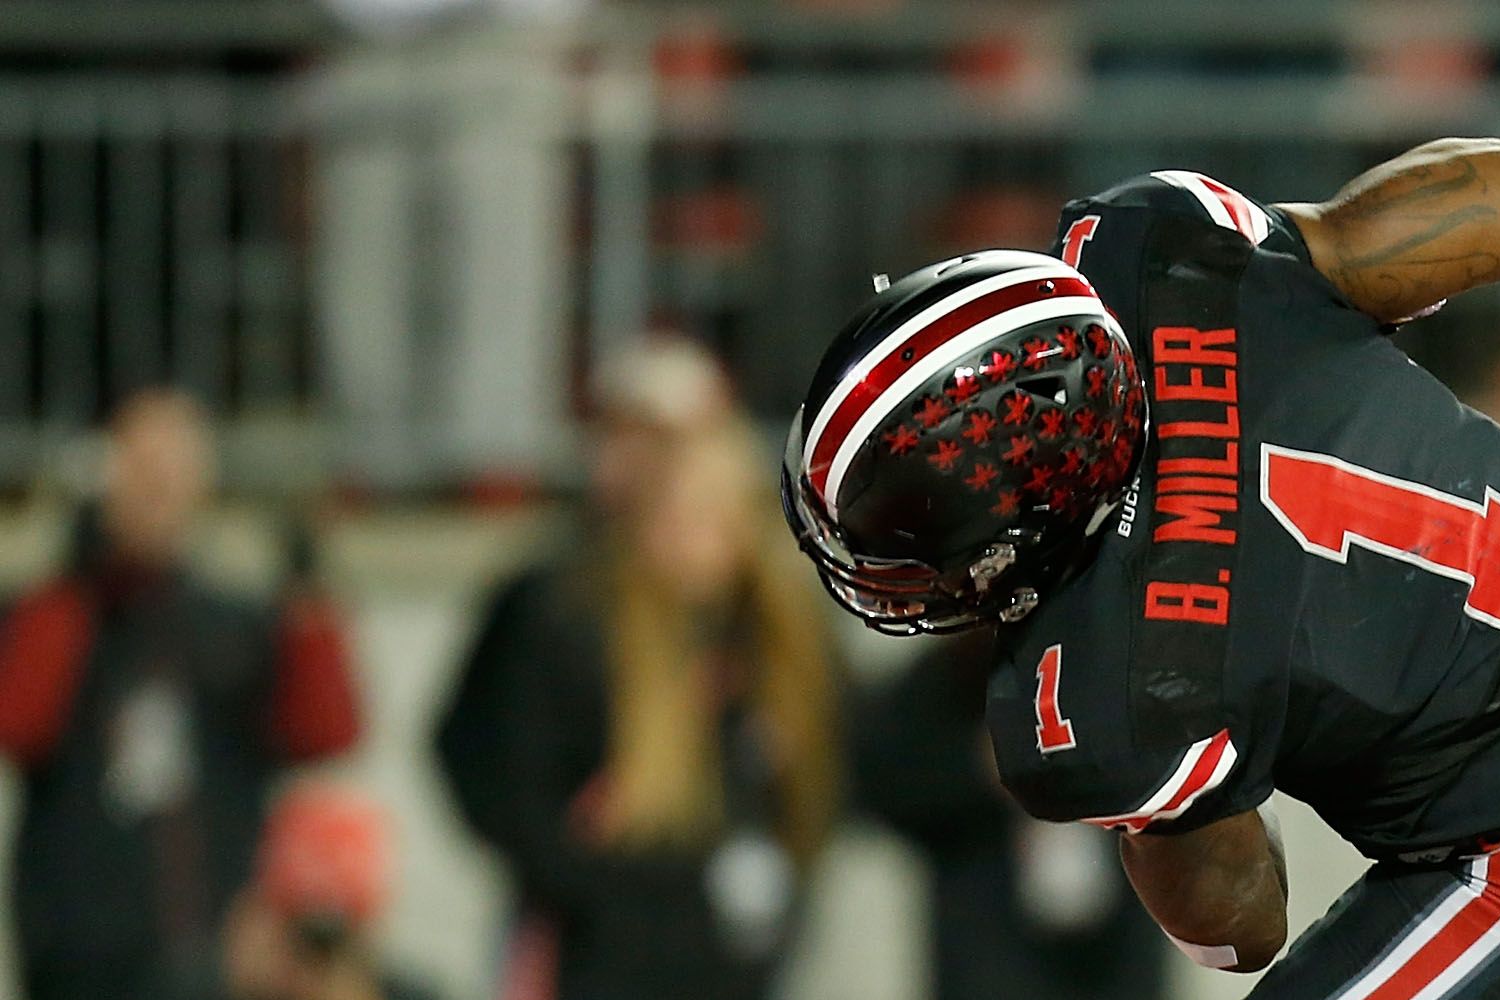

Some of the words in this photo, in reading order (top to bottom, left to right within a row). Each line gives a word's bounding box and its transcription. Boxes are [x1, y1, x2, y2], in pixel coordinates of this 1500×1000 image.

[1152, 326, 1241, 545] MILLER
[1144, 568, 1232, 626] B.
[1034, 643, 1078, 754] 1
